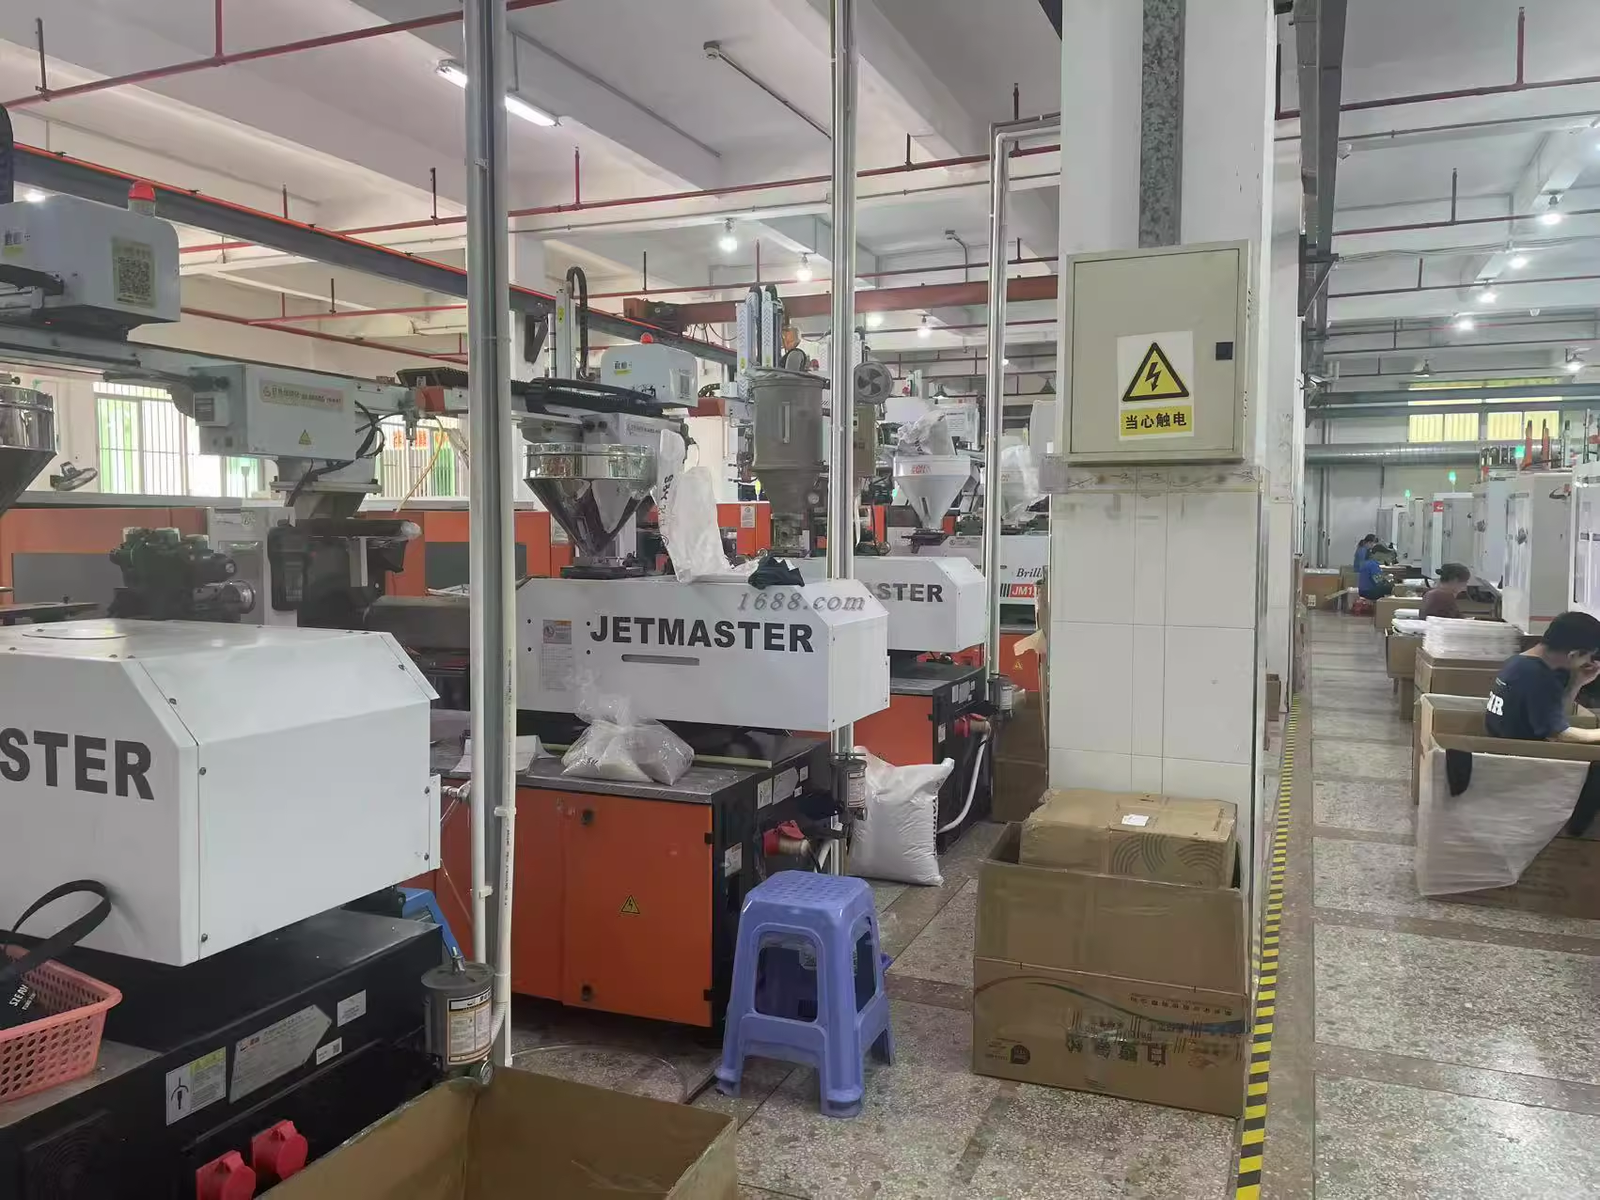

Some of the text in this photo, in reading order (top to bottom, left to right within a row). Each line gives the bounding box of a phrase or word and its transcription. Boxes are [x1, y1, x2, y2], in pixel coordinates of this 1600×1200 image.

[1126, 411, 1187, 430] 当心触电
[1016, 567, 1043, 578] Brill
[1012, 586, 1035, 596] JM1
[590, 615, 814, 653] JETMASTER
[0, 727, 155, 801] STER
